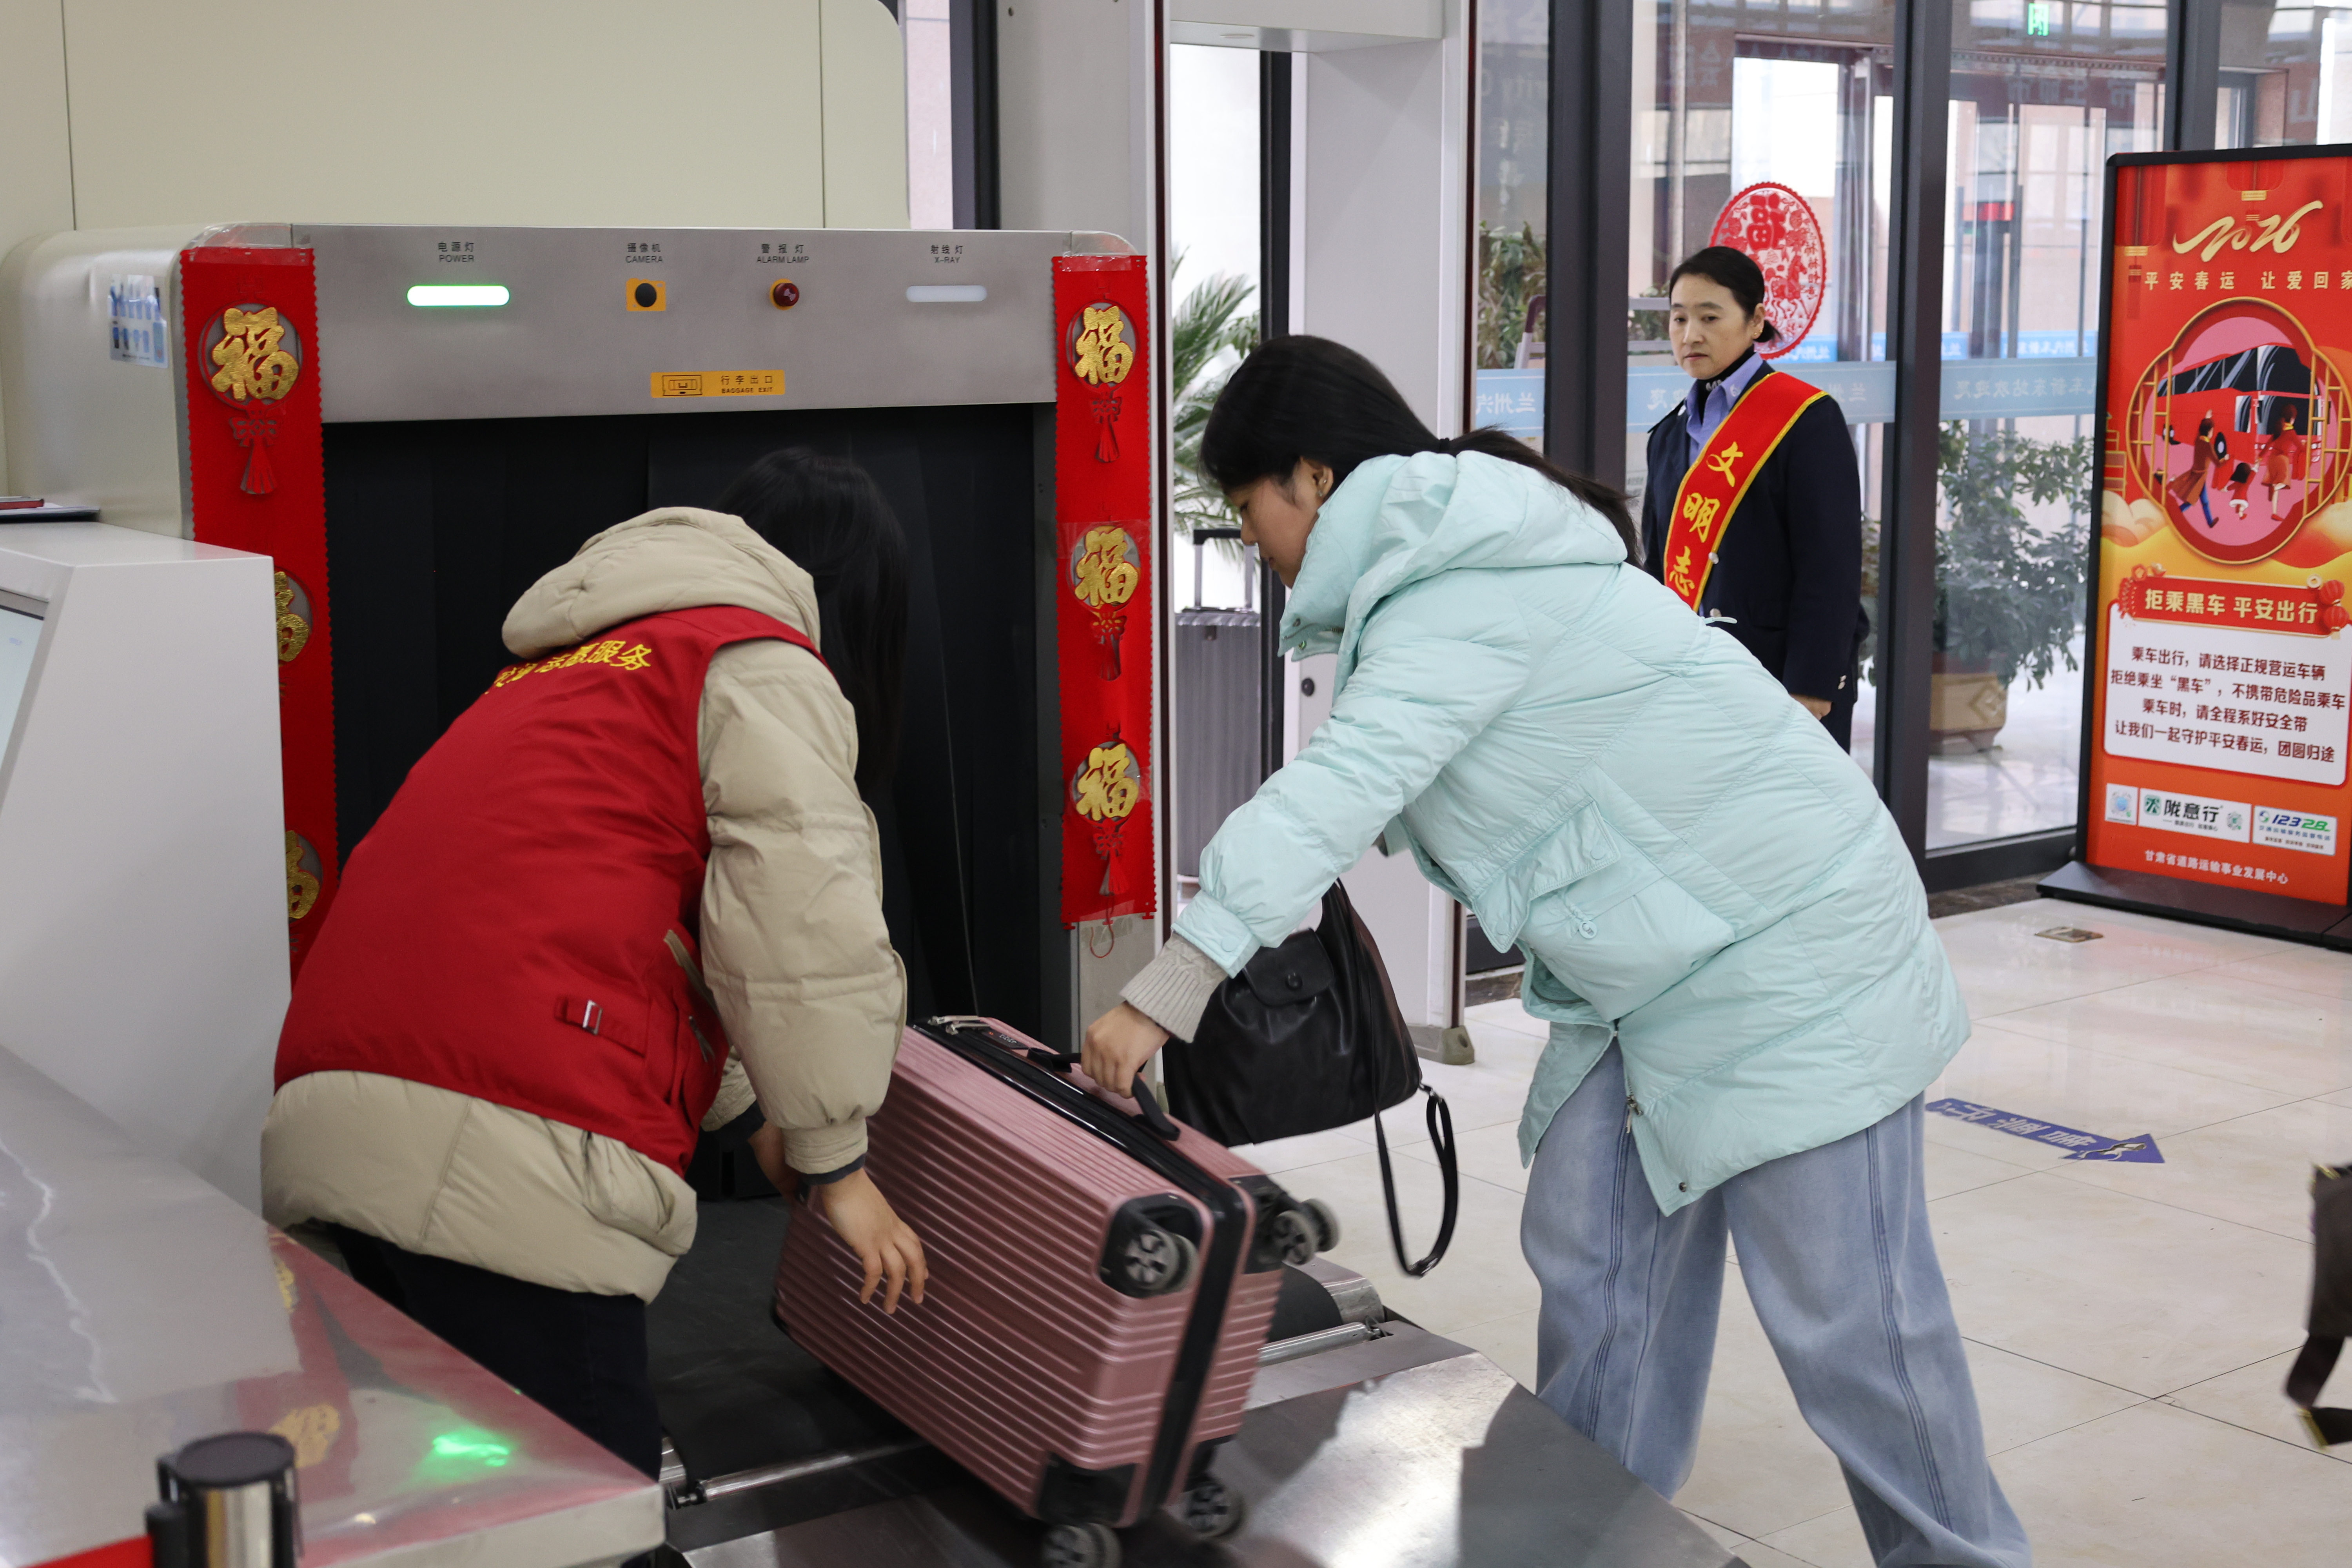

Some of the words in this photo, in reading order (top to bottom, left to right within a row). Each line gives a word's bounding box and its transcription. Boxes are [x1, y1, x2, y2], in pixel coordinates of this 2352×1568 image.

[2172, 200, 2323, 262] 2026
[437, 241, 475, 252] 电源灯
[627, 243, 661, 253] 摄像机
[761, 243, 804, 254] 警报灯
[930, 244, 964, 255] 射线灯
[439, 254, 474, 263] POWER
[626, 255, 662, 263] CAMERA
[2145, 270, 2235, 290] 平安春运
[2261, 270, 2352, 290] 让爱回家
[211, 307, 299, 401] 福
[1075, 305, 1133, 385] 福
[721, 375, 773, 385] 行李出口
[1669, 441, 1744, 597] 文明志
[1076, 527, 1138, 606] 福
[2145, 588, 2226, 615] 拒乘黑车
[2233, 598, 2318, 624] 平安出行
[1076, 744, 1139, 821] 福
[2272, 814, 2330, 831] 12328
